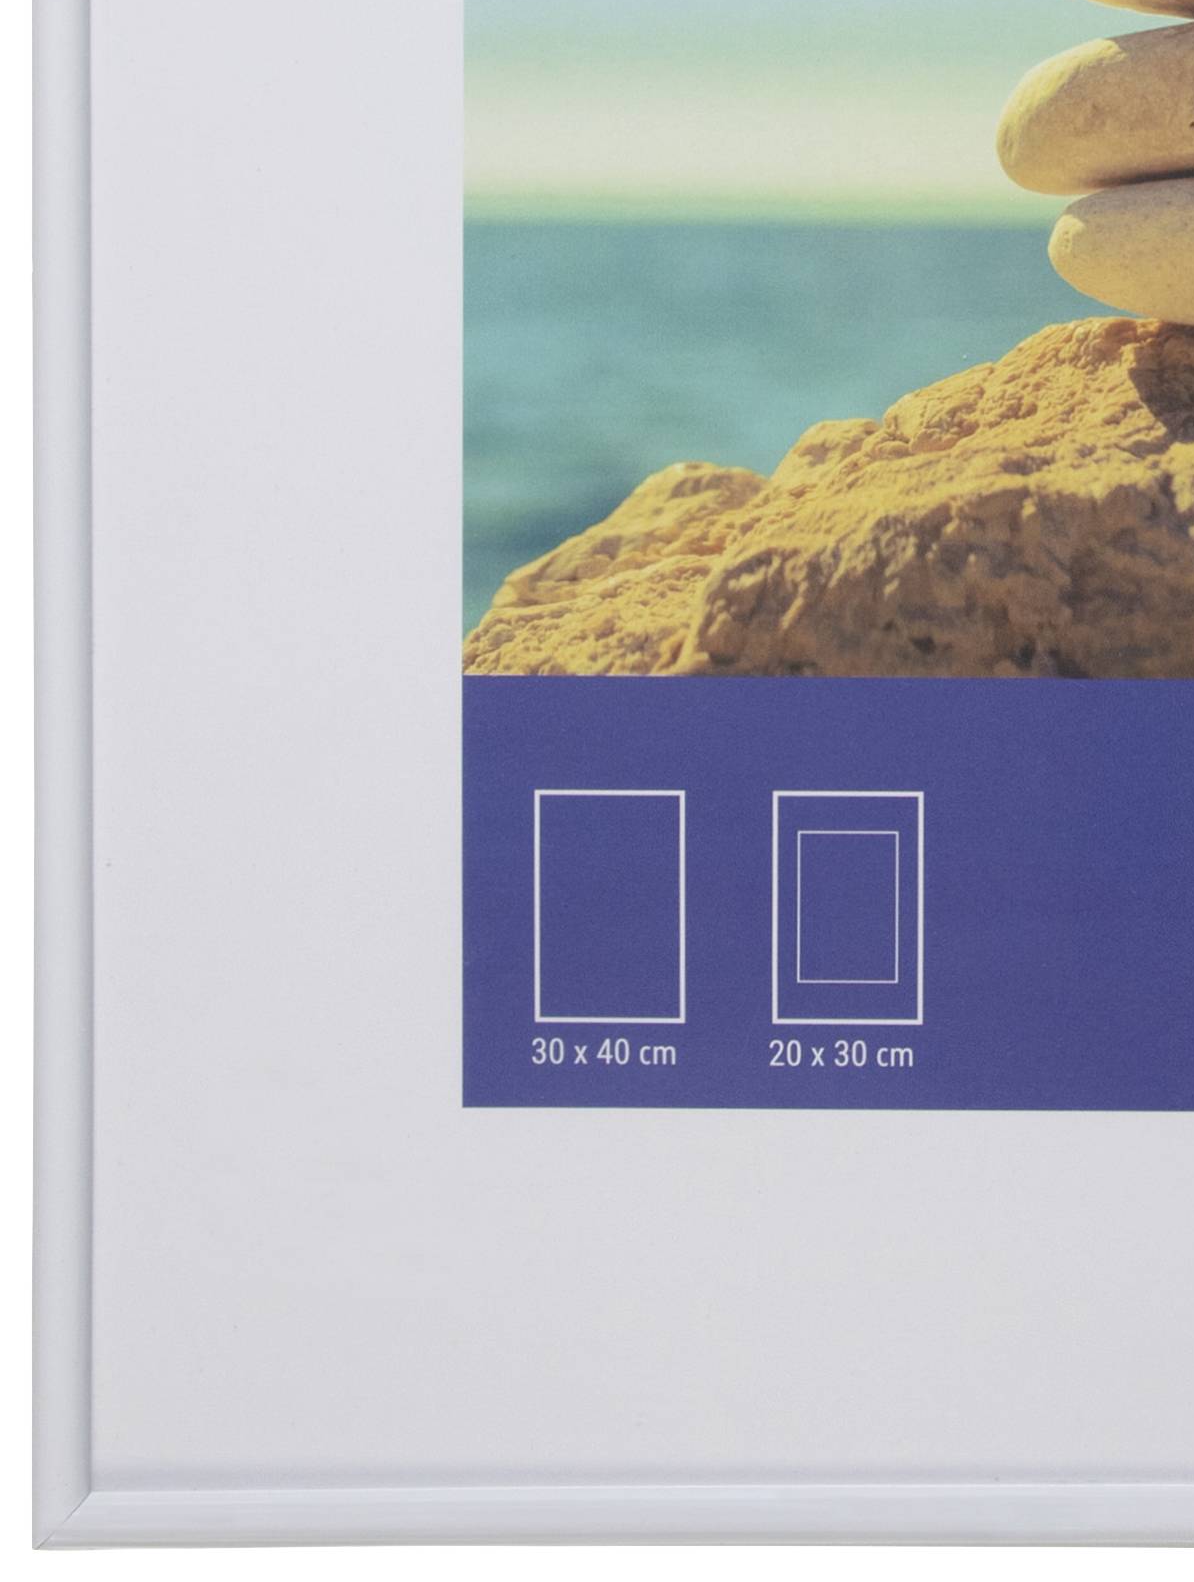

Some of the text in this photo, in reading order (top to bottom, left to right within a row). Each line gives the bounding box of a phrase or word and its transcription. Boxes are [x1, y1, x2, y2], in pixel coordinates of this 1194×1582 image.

[531, 1037, 677, 1066] 30 x 40 cm
[768, 1039, 915, 1068] 20 x 30 cm
